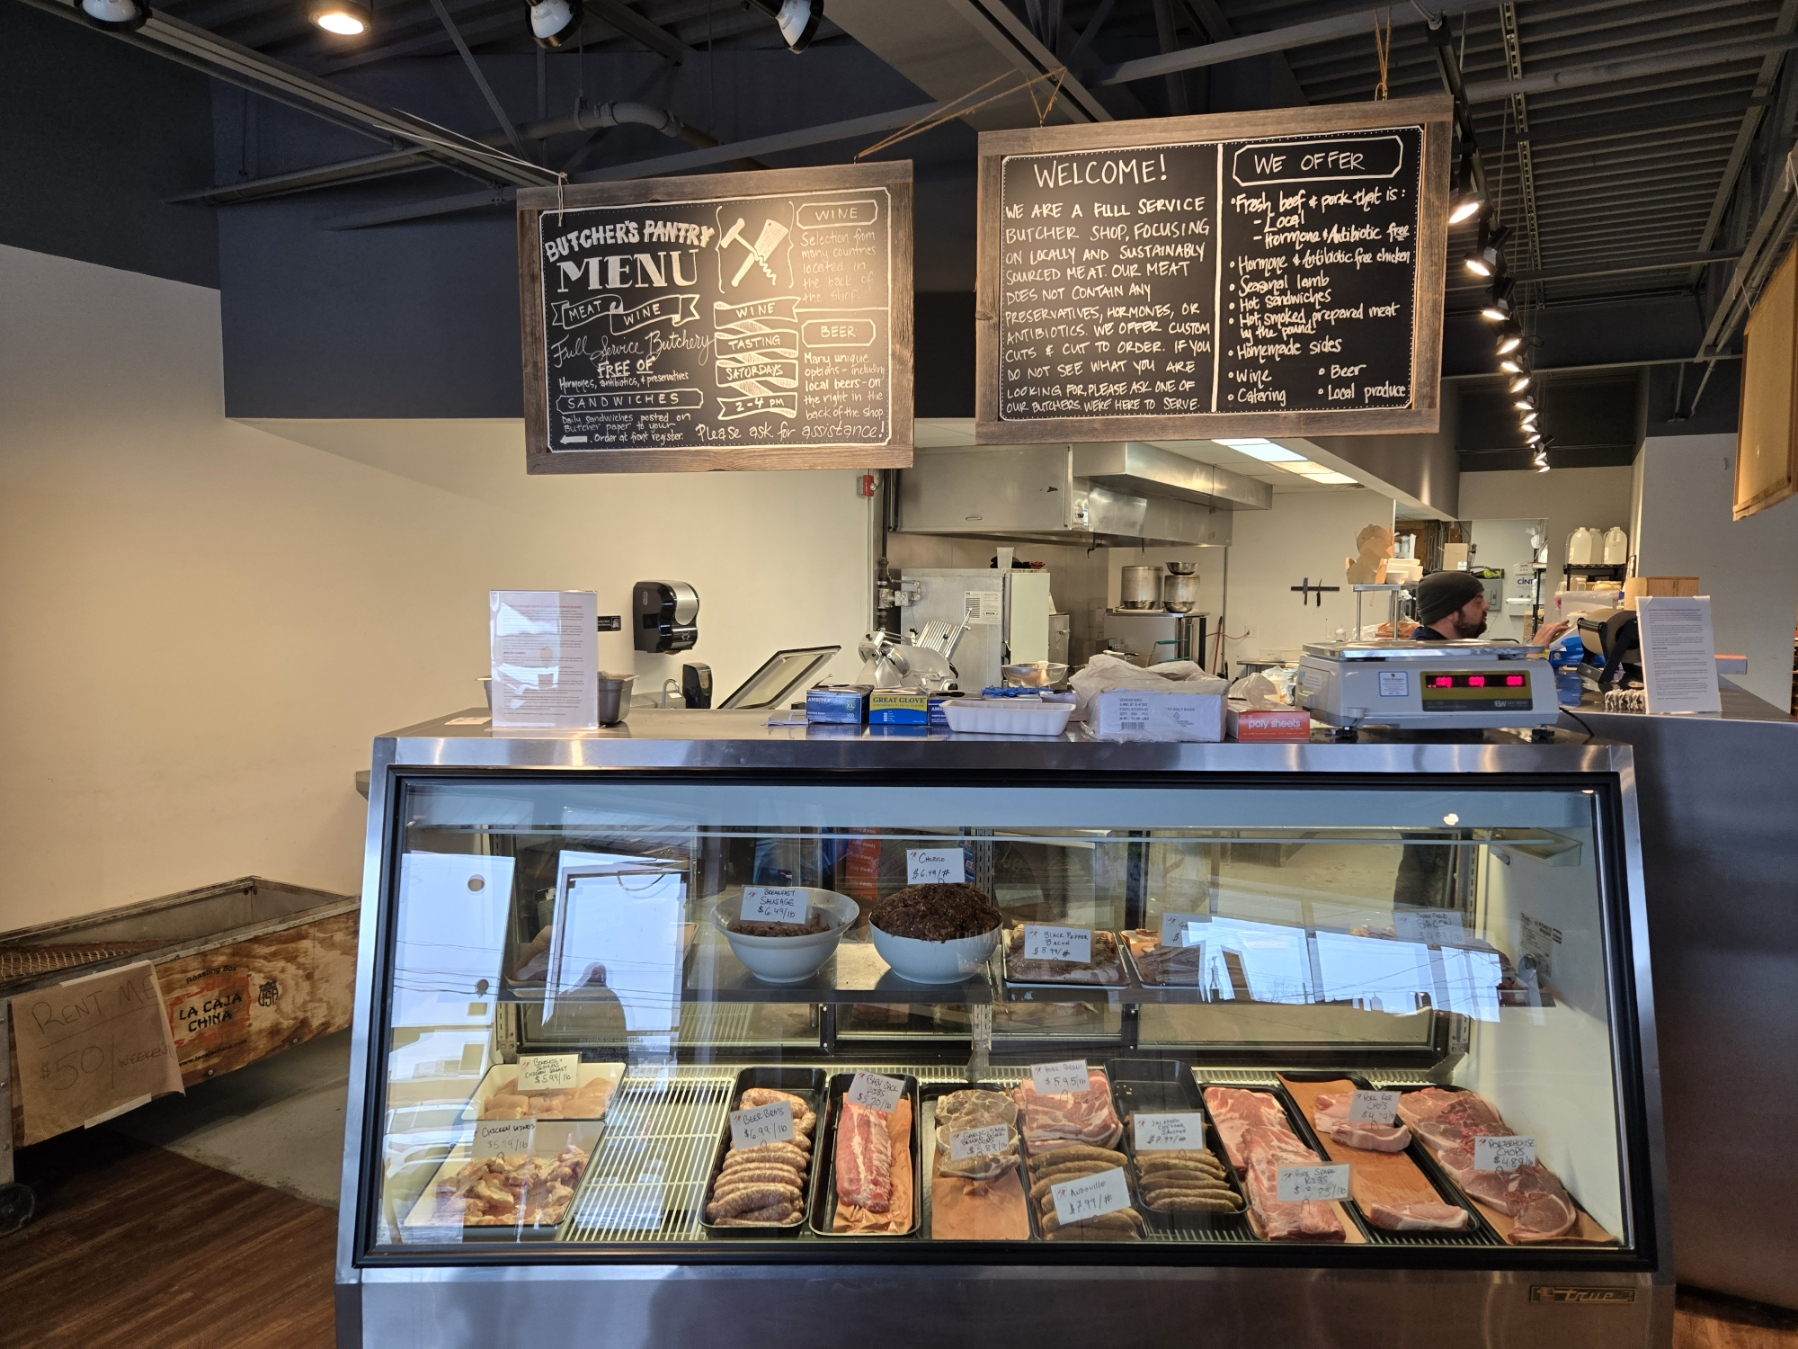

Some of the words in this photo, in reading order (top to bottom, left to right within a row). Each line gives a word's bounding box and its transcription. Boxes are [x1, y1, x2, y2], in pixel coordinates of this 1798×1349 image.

[1033, 154, 1167, 188] WELCOME!
[1254, 153, 1287, 174] WE
[1301, 151, 1365, 171] OFFER
[1005, 204, 1024, 219] WE
[1030, 203, 1063, 218] ARE
[1071, 204, 1083, 219] A
[1094, 202, 1130, 217] FULL
[1137, 197, 1205, 215] SERVICE
[1236, 191, 1275, 216] Fresh
[1279, 189, 1306, 213] beef
[1321, 189, 1353, 213] pork
[1353, 186, 1382, 211] that
[815, 208, 858, 222] WINE
[1264, 209, 1305, 232] Local
[545, 220, 640, 262] BUTCHER'S
[643, 220, 715, 248] PANTRY
[1005, 226, 1079, 244] BUTCHER
[1089, 223, 1129, 242] SHOP,
[1134, 218, 1210, 240] FOCUSING
[1005, 251, 1023, 265] ON
[1030, 247, 1076, 265] LOCALLY
[1082, 248, 1109, 262] AND
[1119, 242, 1206, 262] SUSTAINABLY
[1239, 255, 1288, 276] Hormone
[1302, 247, 1353, 268] Antibiotic
[1354, 248, 1373, 270] free
[1377, 247, 1410, 264] chicken
[557, 249, 699, 293] MENU
[1005, 268, 1060, 286] SOURCED
[1066, 264, 1107, 280] MEAT.
[1111, 263, 1141, 278] OUR
[1146, 261, 1191, 277] MEAT
[1005, 288, 1038, 305] DOES
[1042, 287, 1065, 301] NOT
[1071, 284, 1123, 300] CONTAIN
[1128, 283, 1151, 303] ANY
[1239, 275, 1288, 296] Seasonal
[1297, 270, 1330, 290] lamb
[569, 300, 602, 322] MEAT
[735, 302, 776, 318] WINE
[1240, 296, 1260, 312] Hot
[1265, 289, 1332, 309] sandwiches
[624, 303, 661, 325] WINE
[1005, 306, 1104, 327] PRESERVATIVES,
[1107, 303, 1175, 320] HORMONES,
[1181, 302, 1200, 315] OR
[1263, 308, 1307, 328] smoked
[1311, 302, 1364, 326] prepared
[1368, 302, 1401, 319] meat
[728, 335, 782, 350] TASTING
[821, 325, 856, 338] BEER
[1006, 325, 1088, 346] ANTIBIOTICS.
[1093, 323, 1114, 337] WE
[1118, 321, 1162, 335] OFFER
[1168, 322, 1211, 335] CUSTOM
[551, 333, 591, 368] Full
[592, 335, 644, 364] Service
[645, 330, 715, 367] Butchery
[1005, 346, 1037, 363] CUTS
[1062, 341, 1091, 355] CUT
[1094, 340, 1110, 352] TO
[1117, 341, 1166, 354] ORDER.
[1174, 340, 1188, 353] IF
[1188, 341, 1211, 357] YOU
[1237, 337, 1302, 363] Homemade
[1309, 335, 1343, 355] sides
[597, 360, 631, 377] FREE
[636, 357, 656, 374] OF
[725, 364, 783, 381] SATURDAYS
[1007, 368, 1020, 382] DO
[1027, 366, 1050, 380] NOT
[1057, 362, 1083, 378] SEE
[1090, 360, 1128, 373] WHAT
[1132, 359, 1155, 376] YOU
[1166, 360, 1195, 373] ARE
[1330, 364, 1367, 379] Beer
[1006, 385, 1062, 400] LOOKING
[1088, 382, 1128, 397] PLEASE
[1129, 381, 1152, 394] ASK
[1154, 381, 1175, 393] ONE
[1178, 379, 1195, 392] OF
[1236, 369, 1272, 389] Wine
[568, 393, 680, 409] SANDWICHES
[1237, 388, 1287, 407] Catering
[1328, 382, 1355, 400] Local
[1364, 381, 1406, 404] produce
[1006, 401, 1029, 414] OUR
[1114, 399, 1140, 411] HERE
[1144, 399, 1155, 410] TO
[1163, 397, 1200, 411] SERVE.
[695, 423, 742, 442] Please
[749, 421, 774, 440] ask
[777, 421, 797, 441] for
[802, 420, 885, 439] assistance!
[1249, 719, 1268, 730] poly
[1271, 719, 1301, 728] sheets
[186, 966, 221, 984] Roasting
[223, 964, 238, 974] Box
[32, 990, 105, 1034] RENT
[118, 974, 161, 1004] ME
[179, 1006, 198, 1021] LA
[203, 992, 242, 1013] CAJA
[257, 988, 279, 1008] USA
[188, 1010, 232, 1033] CHINA
